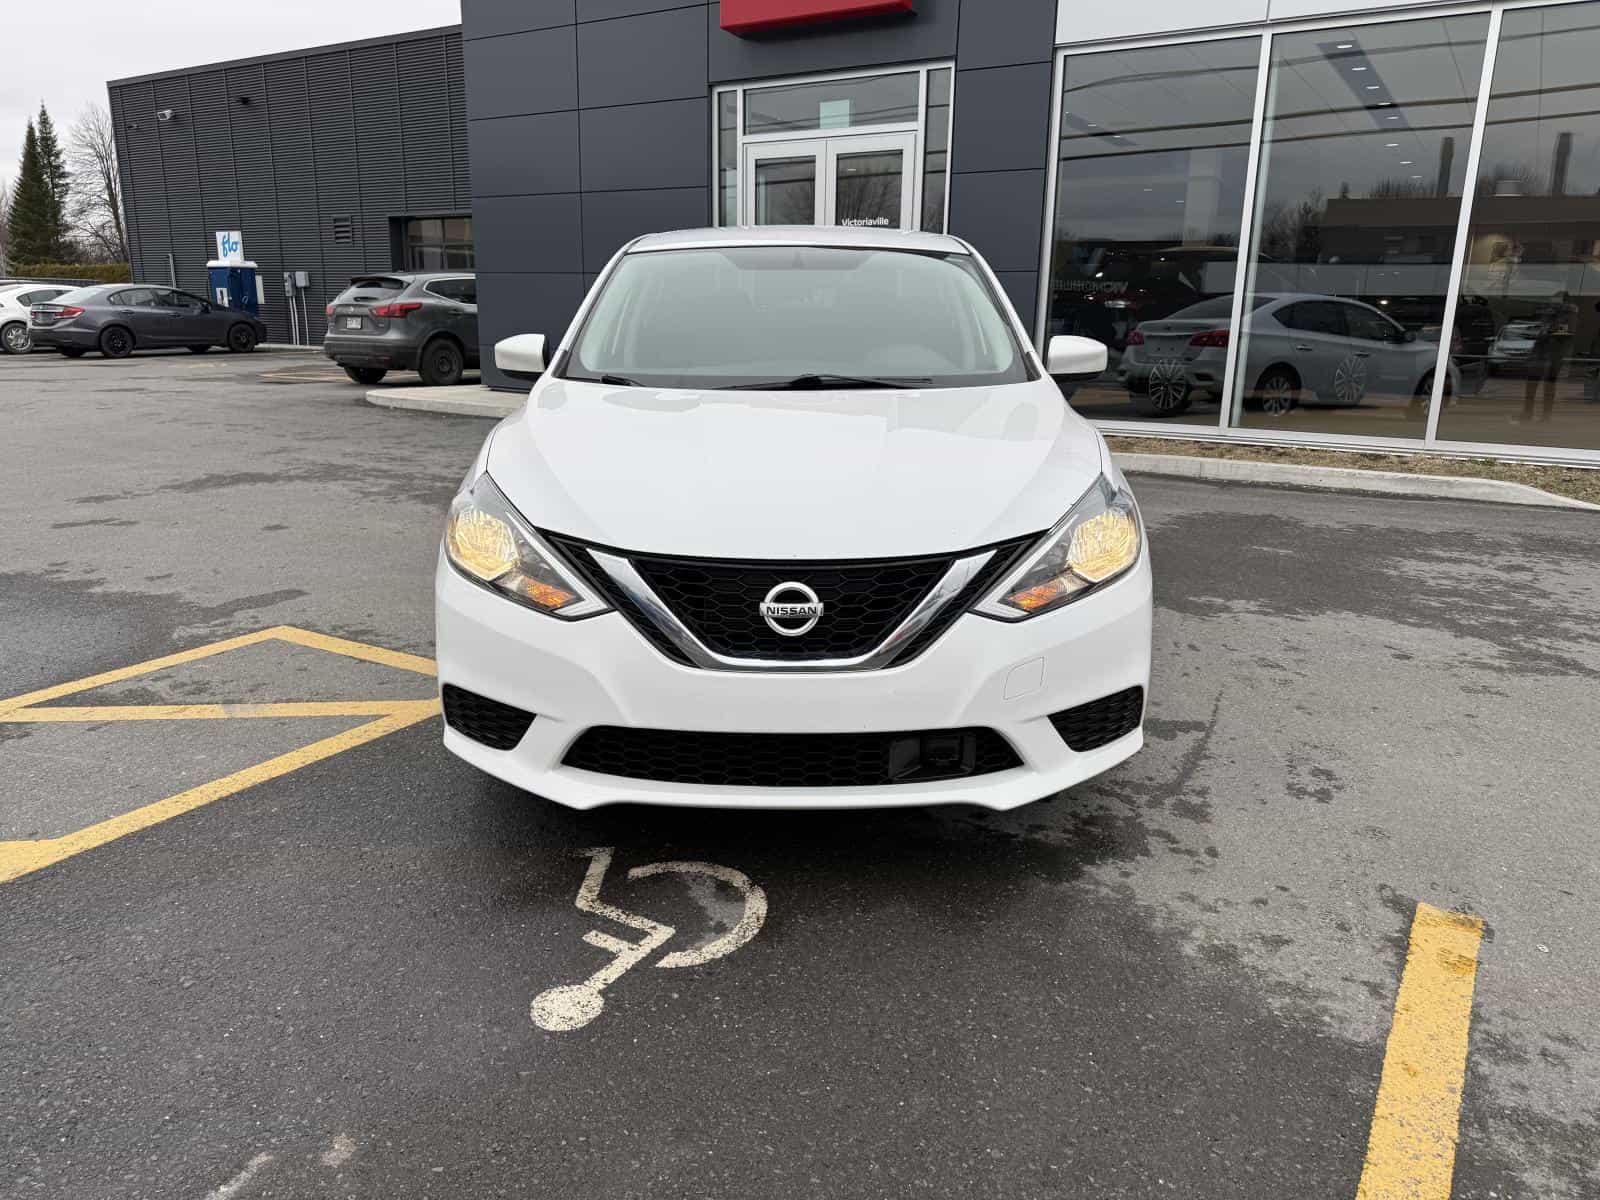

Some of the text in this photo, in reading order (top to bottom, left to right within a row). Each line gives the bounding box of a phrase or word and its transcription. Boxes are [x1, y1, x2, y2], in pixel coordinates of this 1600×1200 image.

[841, 216, 889, 226] Victoriaville
[221, 232, 239, 257] flo
[766, 606, 817, 615] NISSAN
